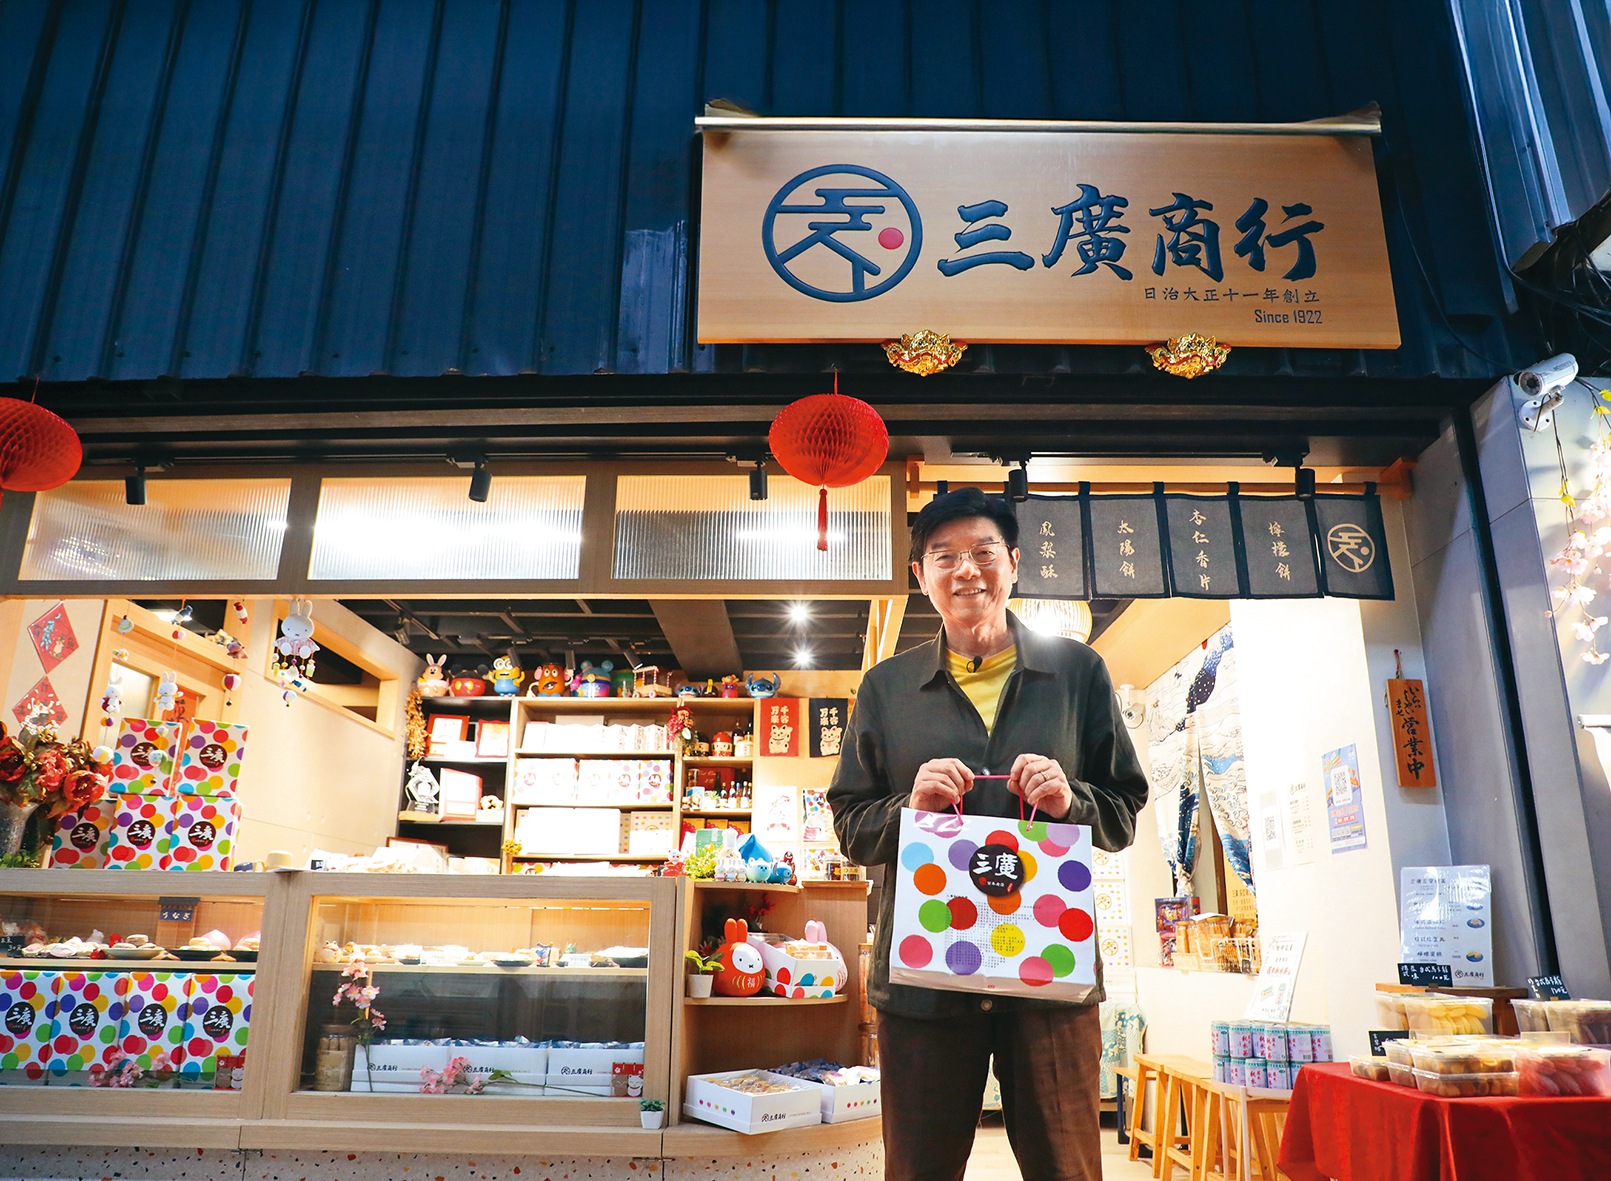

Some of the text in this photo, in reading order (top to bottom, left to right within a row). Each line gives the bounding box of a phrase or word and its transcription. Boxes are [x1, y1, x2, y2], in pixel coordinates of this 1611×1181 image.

[937, 183, 1325, 282] 三廣商行
[1144, 287, 1320, 304] 日治大正十一年創立
[1254, 309, 1323, 324] Since 1922
[1039, 520, 1059, 579] 鳳梨酥
[1117, 519, 1135, 580] 太陽餅
[1188, 508, 1211, 591] 杏仁香片
[1268, 520, 1291, 581] 檸檬餅
[972, 851, 1019, 880] 三廣
[6, 1007, 33, 1026] 三廣
[70, 1008, 97, 1027] 三廣
[139, 1008, 166, 1027] 三廣
[203, 1010, 231, 1029] 三廣
